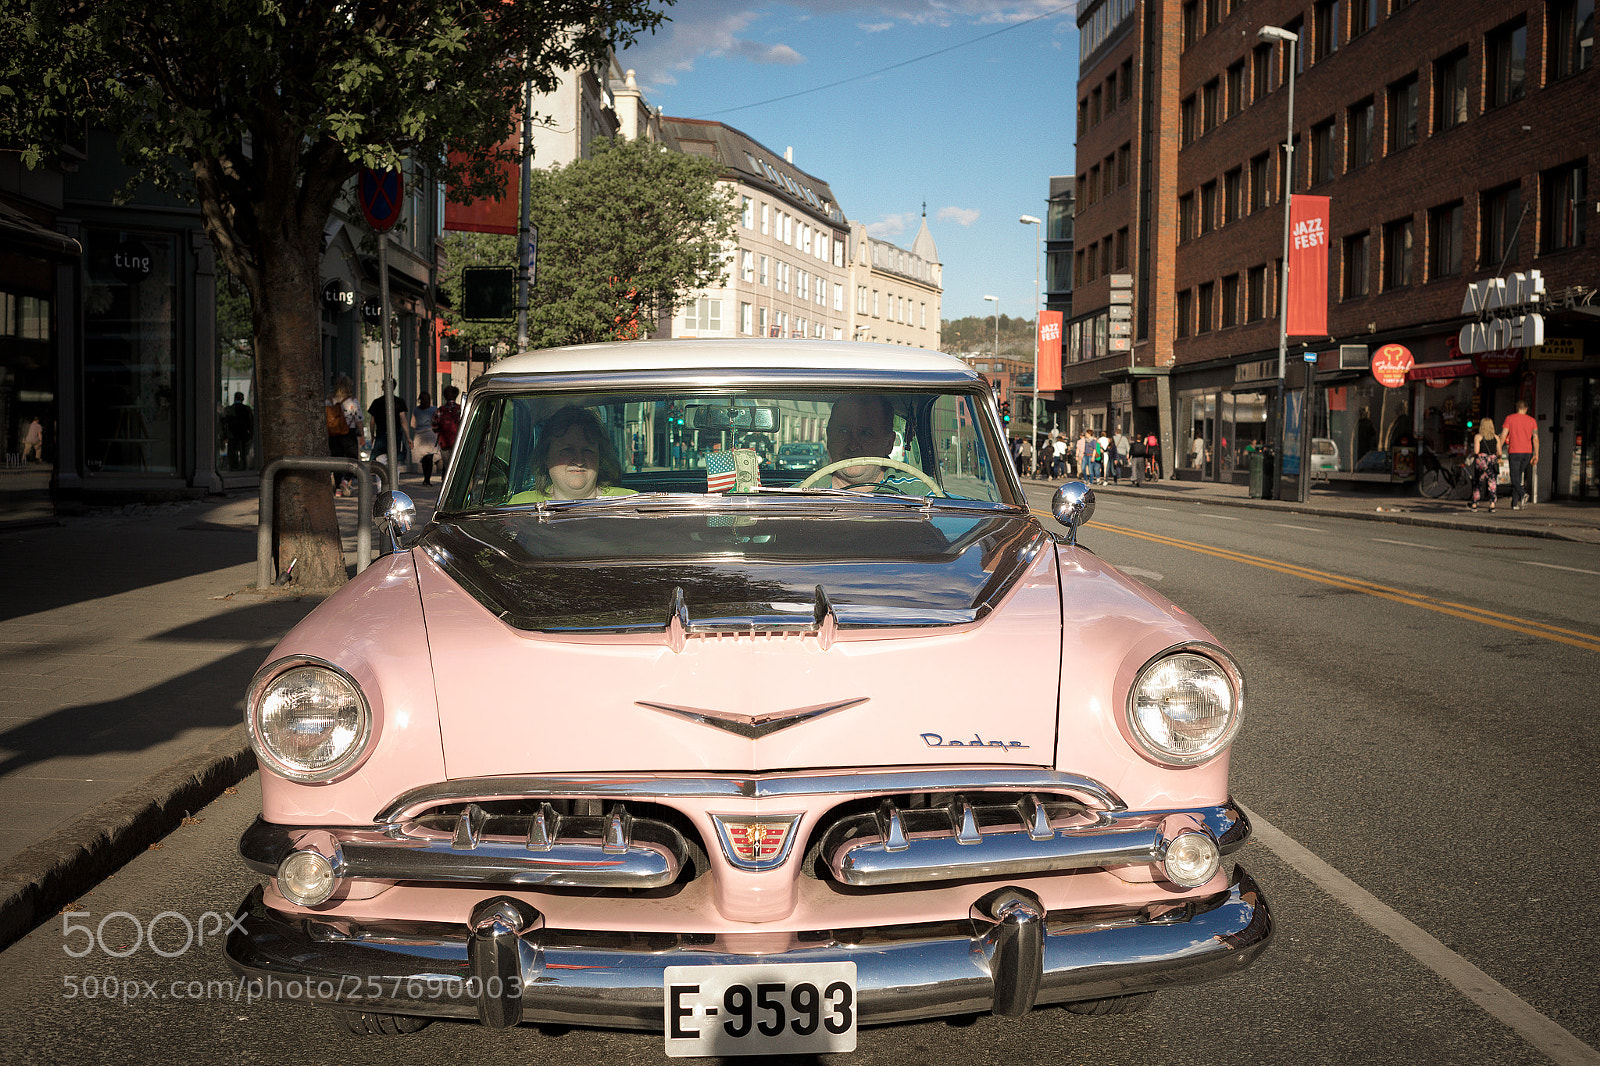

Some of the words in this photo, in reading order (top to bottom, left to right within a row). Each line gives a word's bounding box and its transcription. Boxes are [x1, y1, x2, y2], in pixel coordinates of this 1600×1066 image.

[1293, 218, 1323, 236] JAZZ
[1294, 232, 1325, 250] FEST
[114, 252, 150, 273] ting
[325, 289, 354, 305] ting
[1040, 323, 1059, 333] JAZZ
[1041, 331, 1060, 342] FEST
[919, 732, 1030, 752] Dodge
[669, 980, 853, 1039] E-9593
